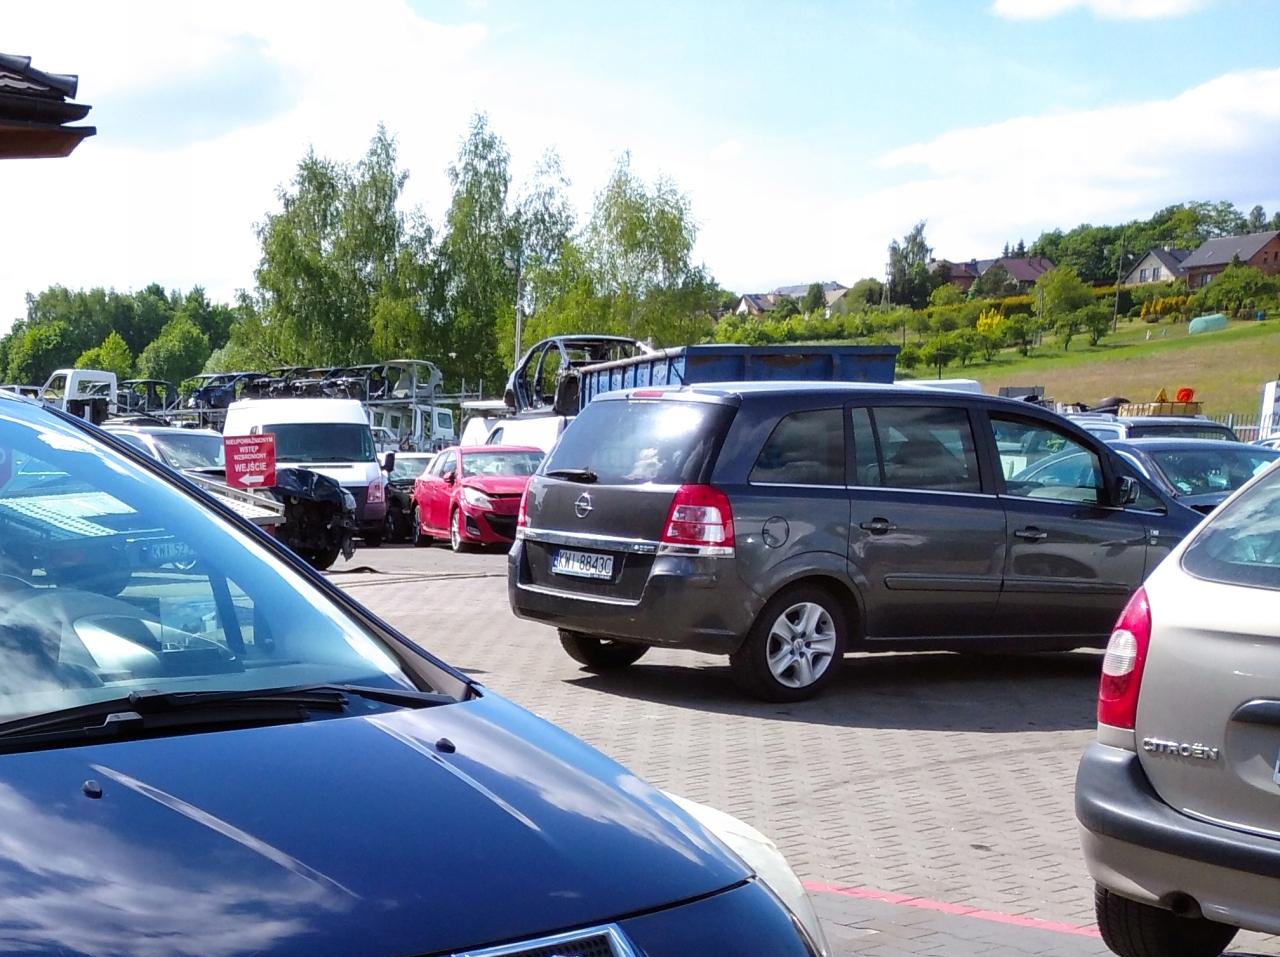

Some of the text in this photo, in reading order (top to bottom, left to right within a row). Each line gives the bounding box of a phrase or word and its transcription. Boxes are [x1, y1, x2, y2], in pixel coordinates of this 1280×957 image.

[239, 445, 259, 454] WSTĘP
[234, 460, 267, 473] WEJŚCIE
[559, 551, 612, 574] KWI 8843C
[1143, 737, 1220, 760] CITROËN
